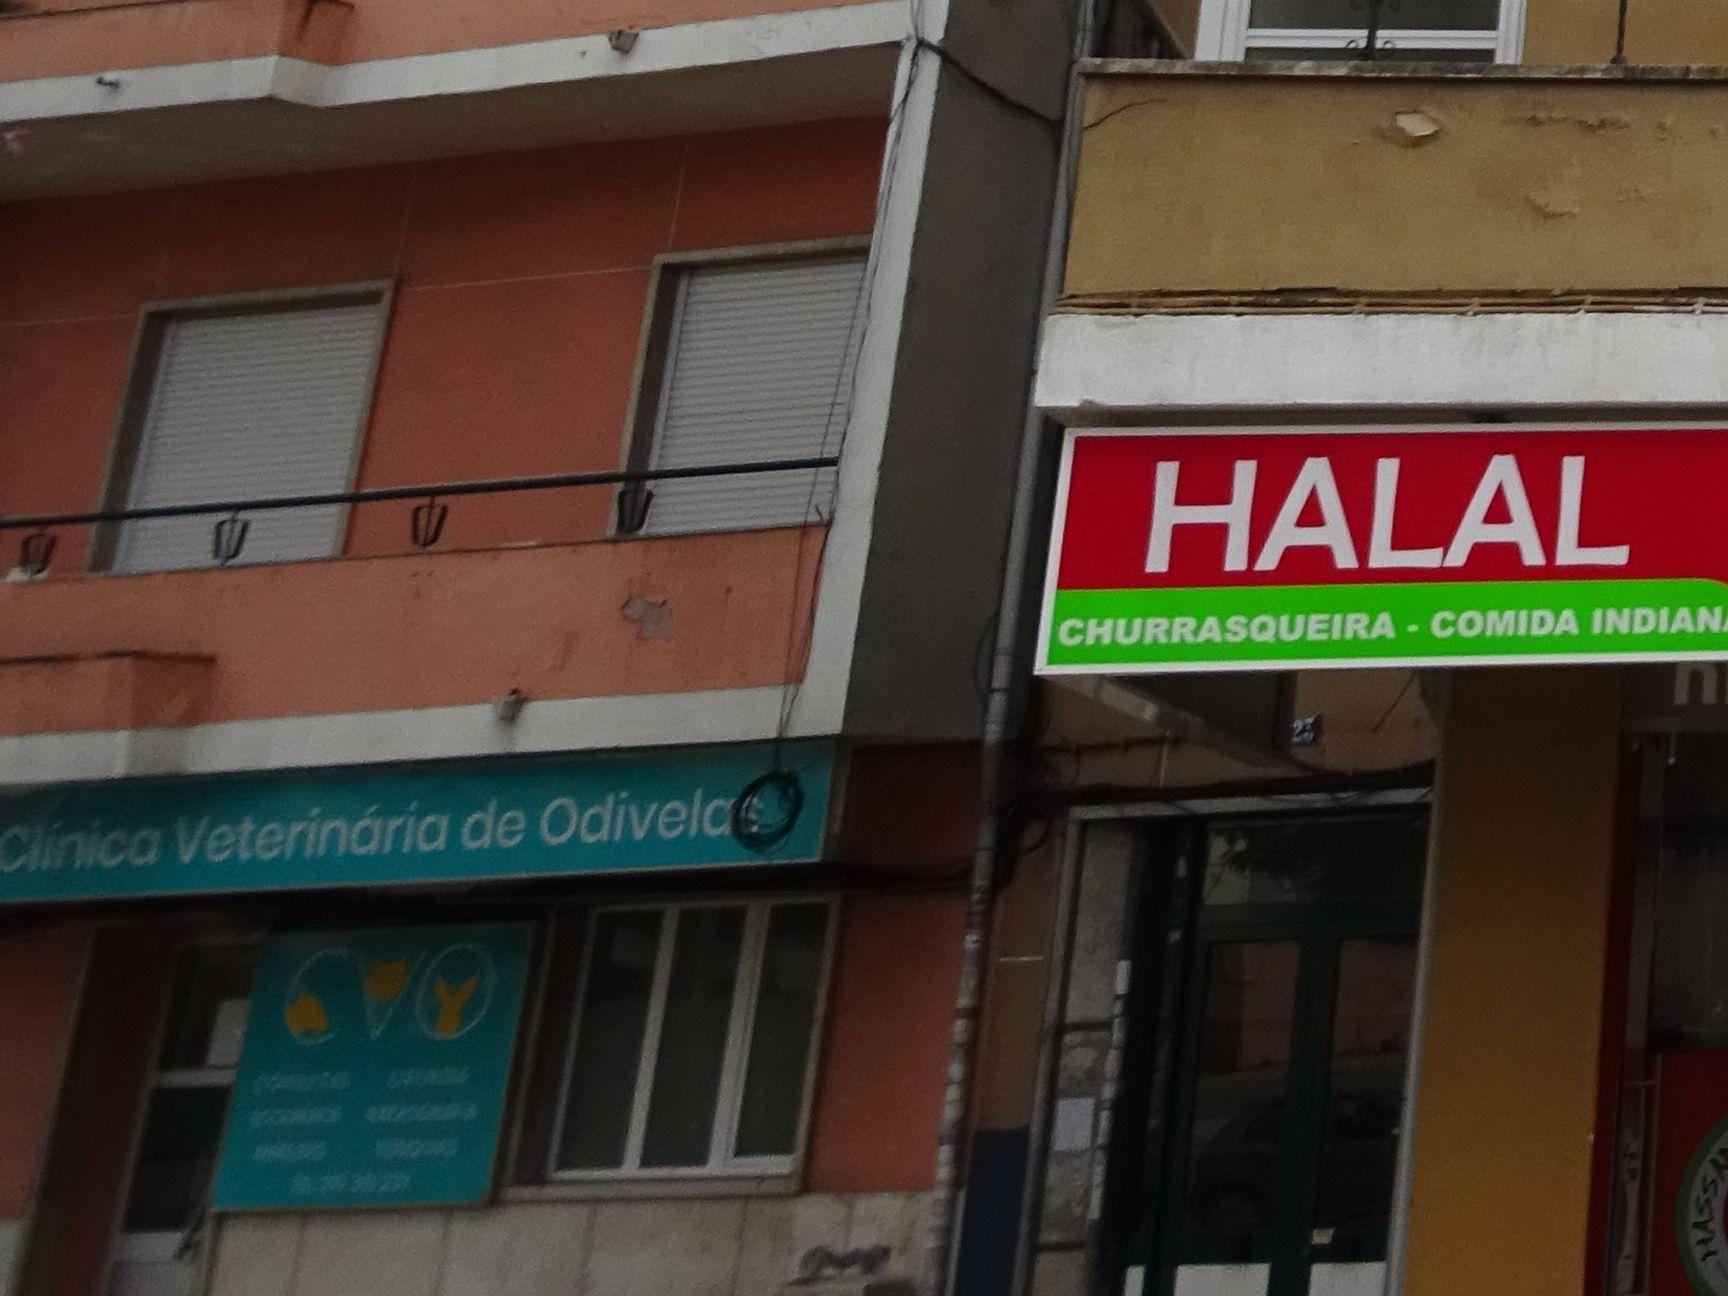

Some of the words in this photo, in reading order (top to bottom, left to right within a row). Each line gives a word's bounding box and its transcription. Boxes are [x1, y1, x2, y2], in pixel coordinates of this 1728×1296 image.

[1143, 453, 1631, 574] HALAL
[1059, 610, 1395, 647] CHURRASQUEIRA
[1430, 606, 1578, 638] COMIDA
[0, 821, 158, 873] Clínica
[176, 800, 448, 864] Veterinária
[461, 801, 526, 850] de
